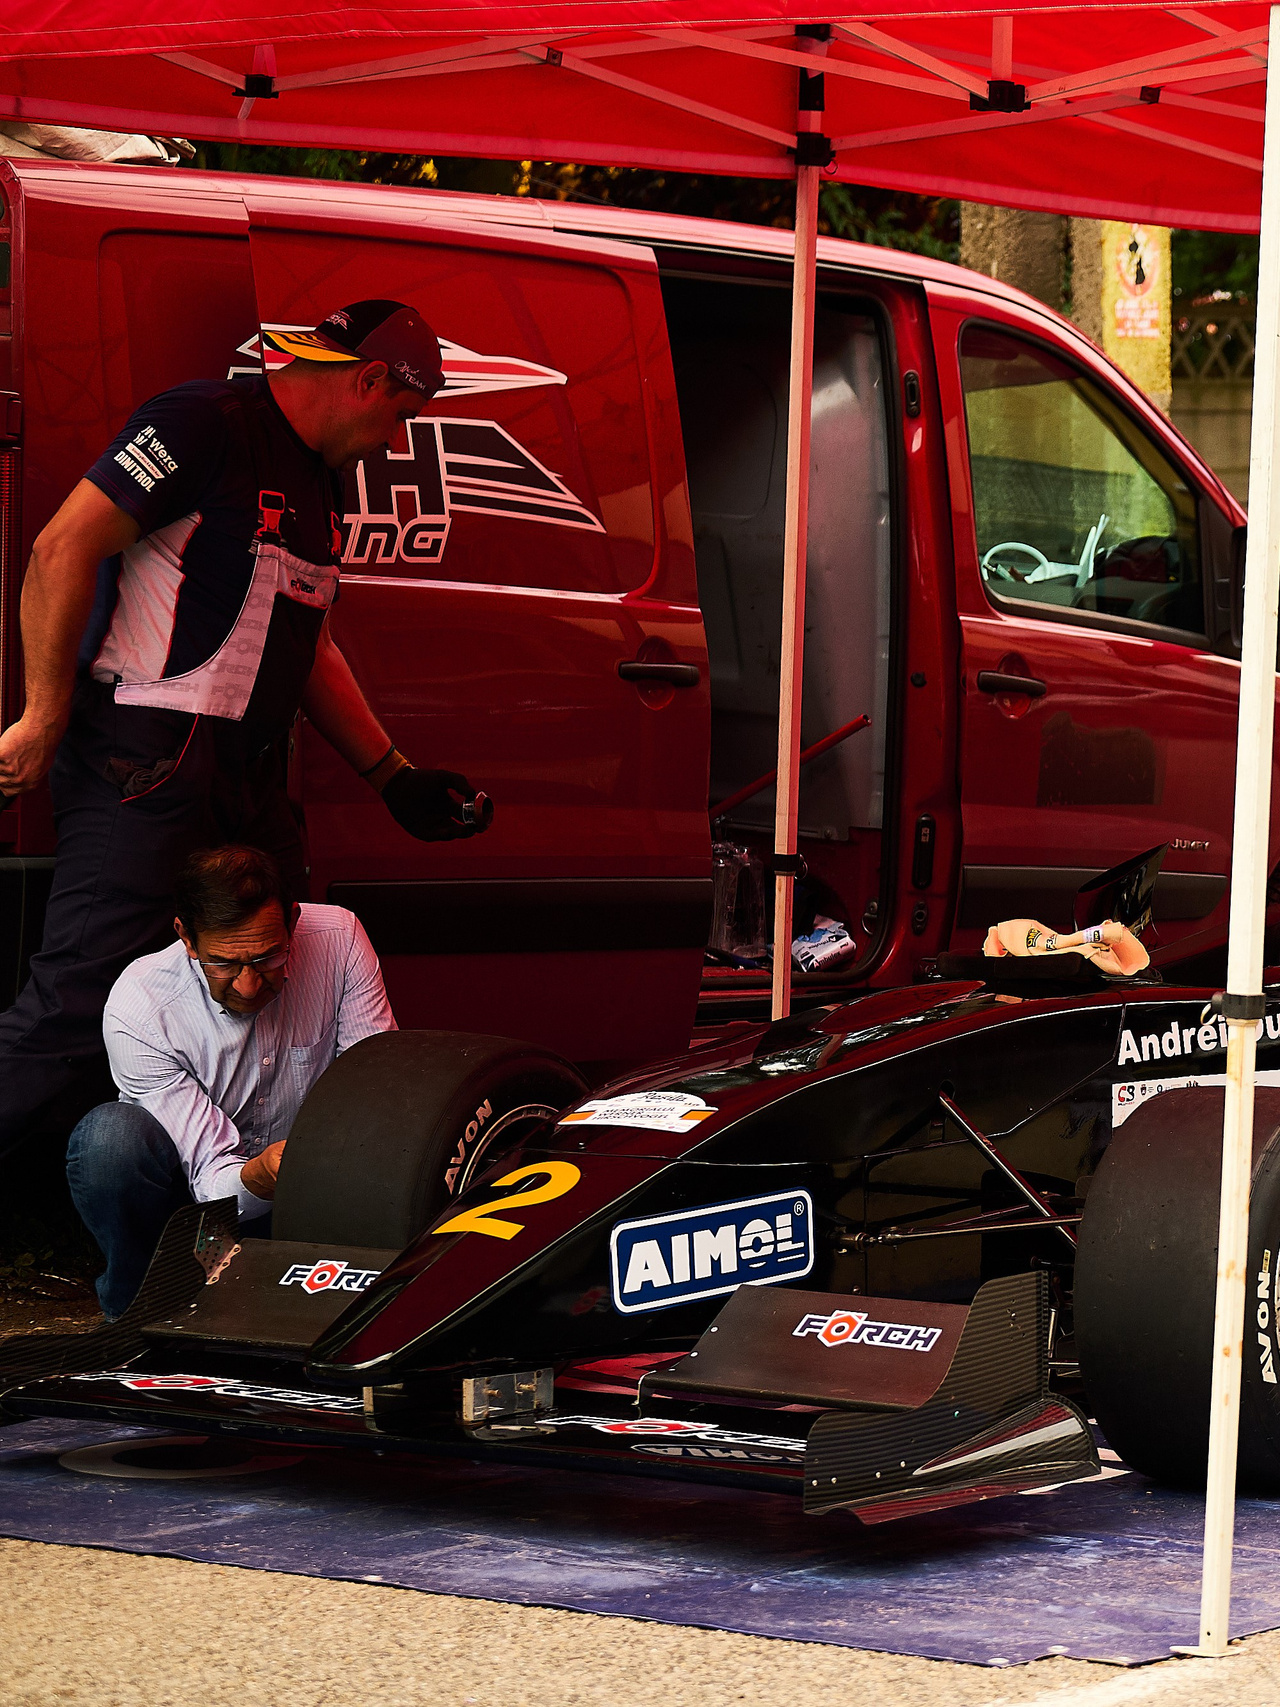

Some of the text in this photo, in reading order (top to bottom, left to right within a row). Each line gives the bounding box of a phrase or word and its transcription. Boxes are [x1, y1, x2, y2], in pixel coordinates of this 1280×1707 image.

[405, 372, 426, 391] TEAM
[113, 450, 155, 492] DINITROL
[149, 437, 178, 471] Wera
[1171, 838, 1210, 850] JUMPY
[1117, 1016, 1229, 1066] Andrei
[444, 1098, 493, 1196] AVON
[431, 1160, 581, 1241] 2
[622, 1213, 806, 1295] AIMOL
[1257, 1271, 1278, 1384] AVON
